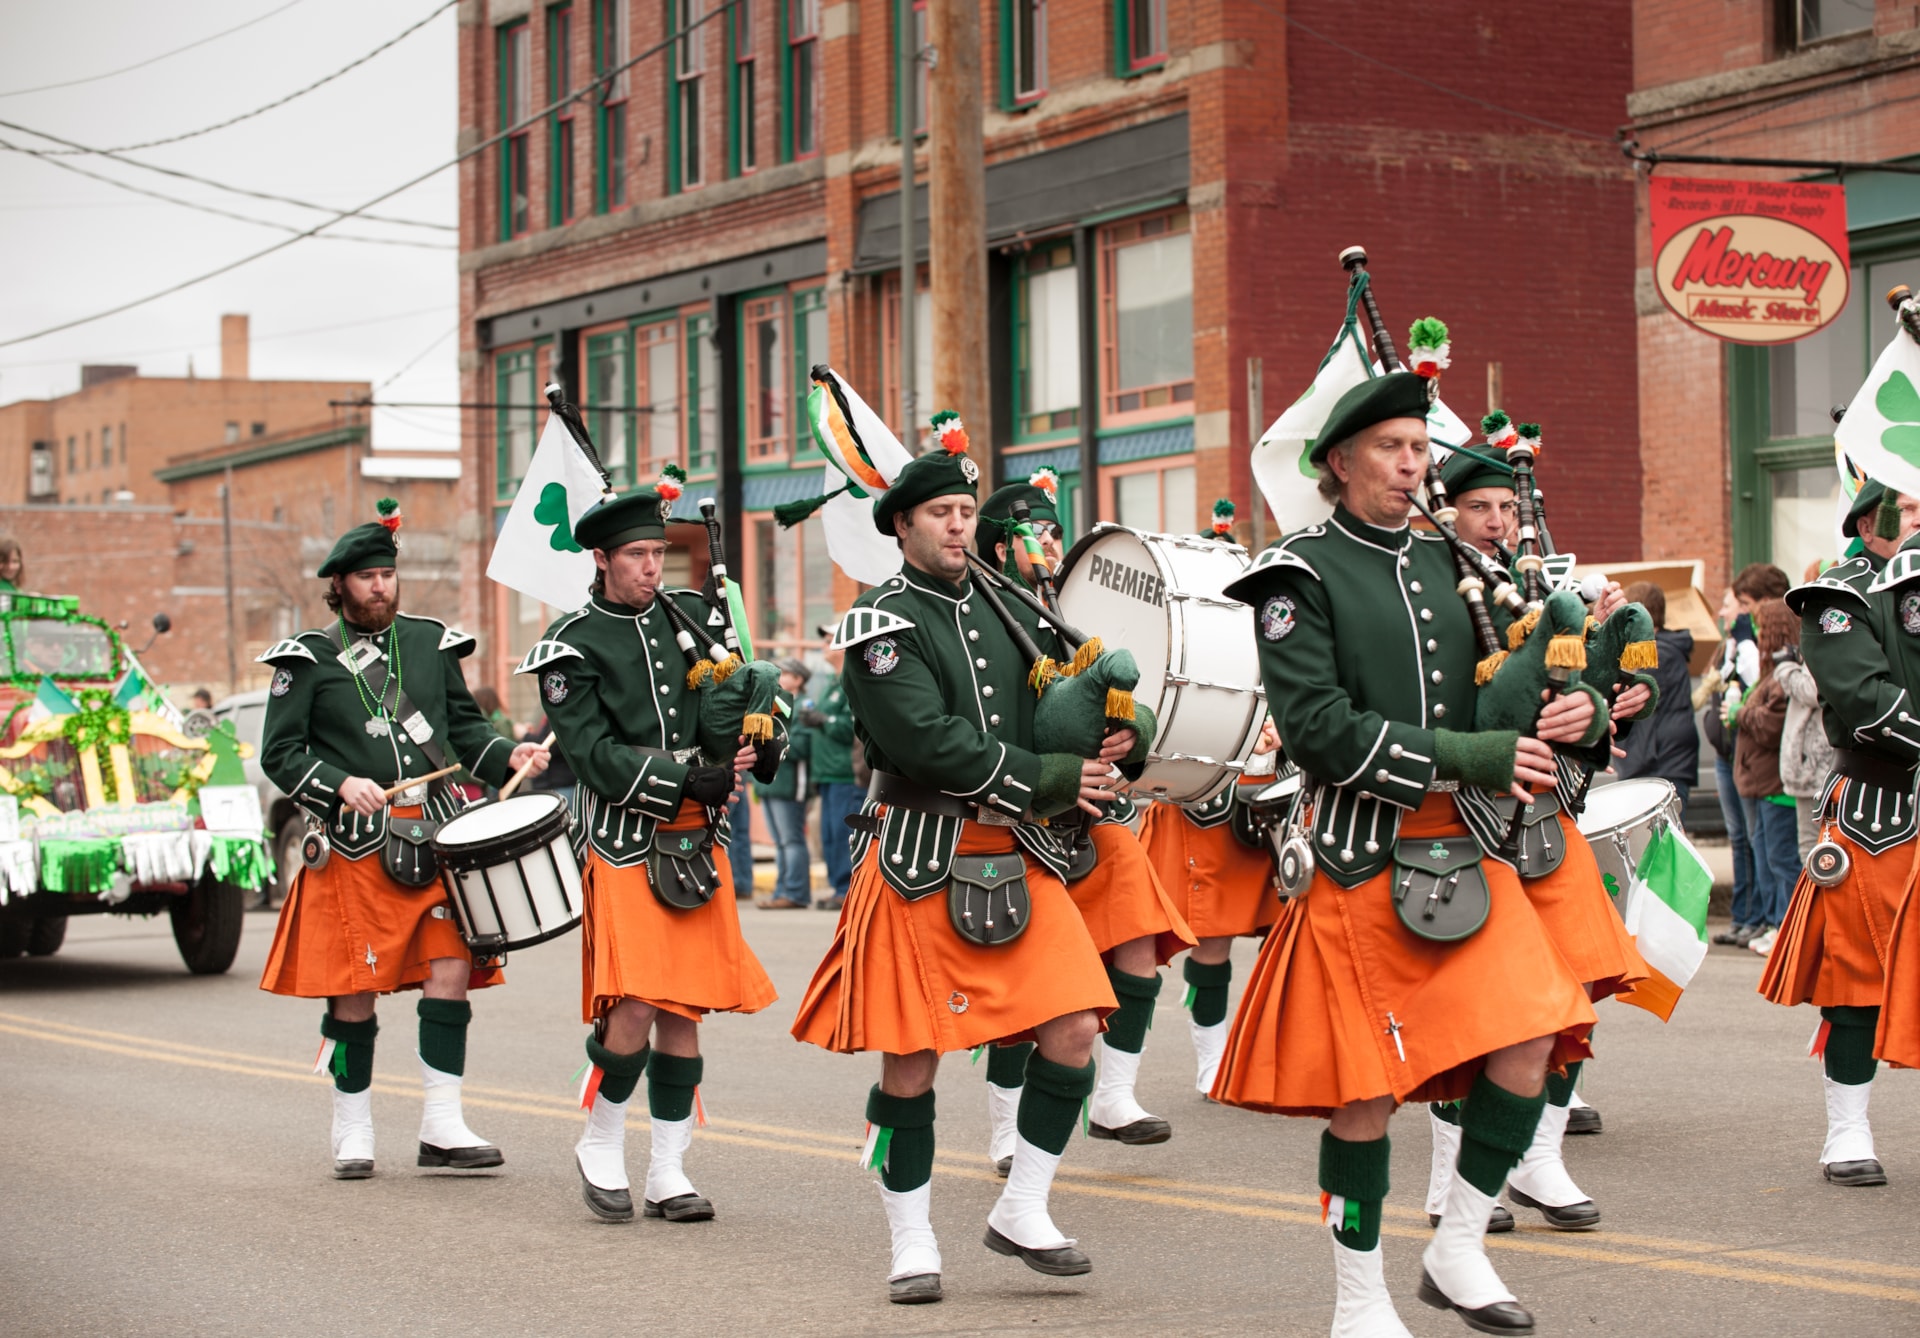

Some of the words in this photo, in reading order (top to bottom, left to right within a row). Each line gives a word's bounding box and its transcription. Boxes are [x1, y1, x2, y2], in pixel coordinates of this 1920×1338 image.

[1669, 177, 1735, 193] Instruments
[1747, 182, 1790, 198] Vintage
[1792, 184, 1832, 199] Clothes
[1668, 196, 1711, 211] Records
[1789, 202, 1826, 218] Supply
[1672, 225, 1832, 306] Mercury
[1692, 297, 1758, 320] Music
[1762, 301, 1820, 323] Store
